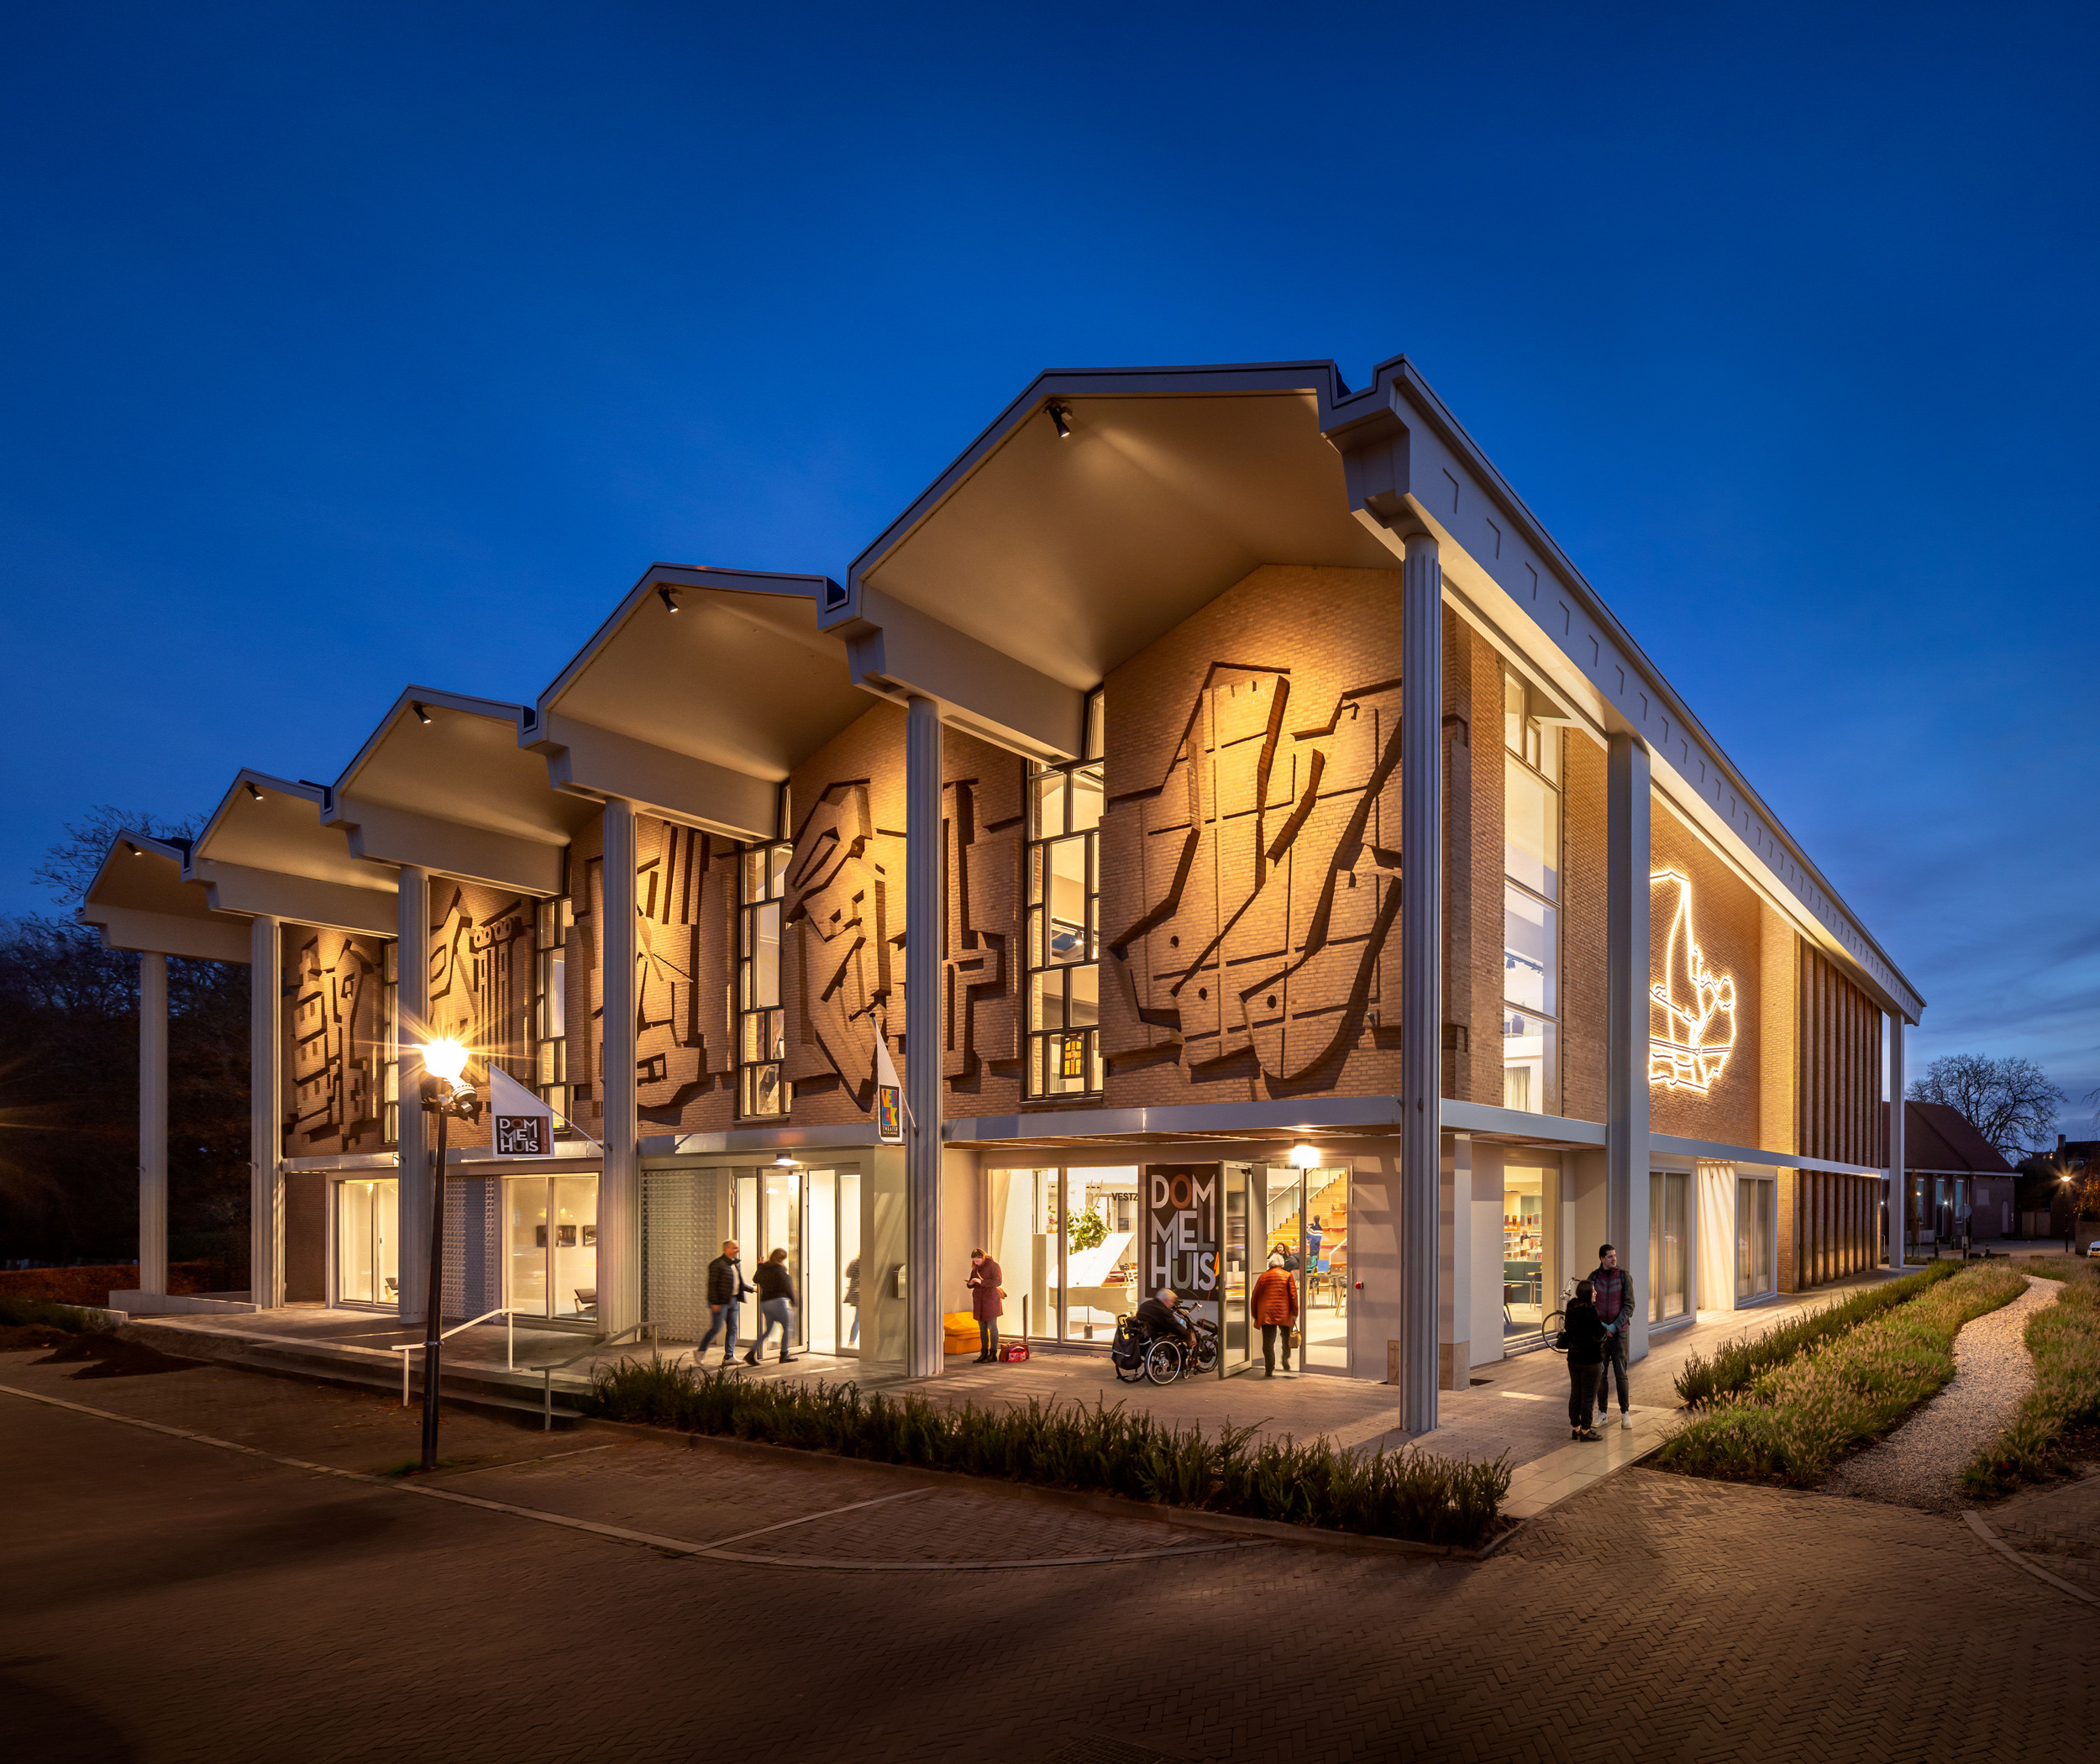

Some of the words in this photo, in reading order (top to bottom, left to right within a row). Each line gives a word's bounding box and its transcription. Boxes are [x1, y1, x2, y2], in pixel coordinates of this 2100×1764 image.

[499, 1118, 538, 1138] DOM
[501, 1137, 539, 1152] HUIS
[1111, 1192, 1139, 1201] VESTZ
[1151, 1173, 1215, 1242] DOM
[1150, 1236, 1216, 1291] HUIS
